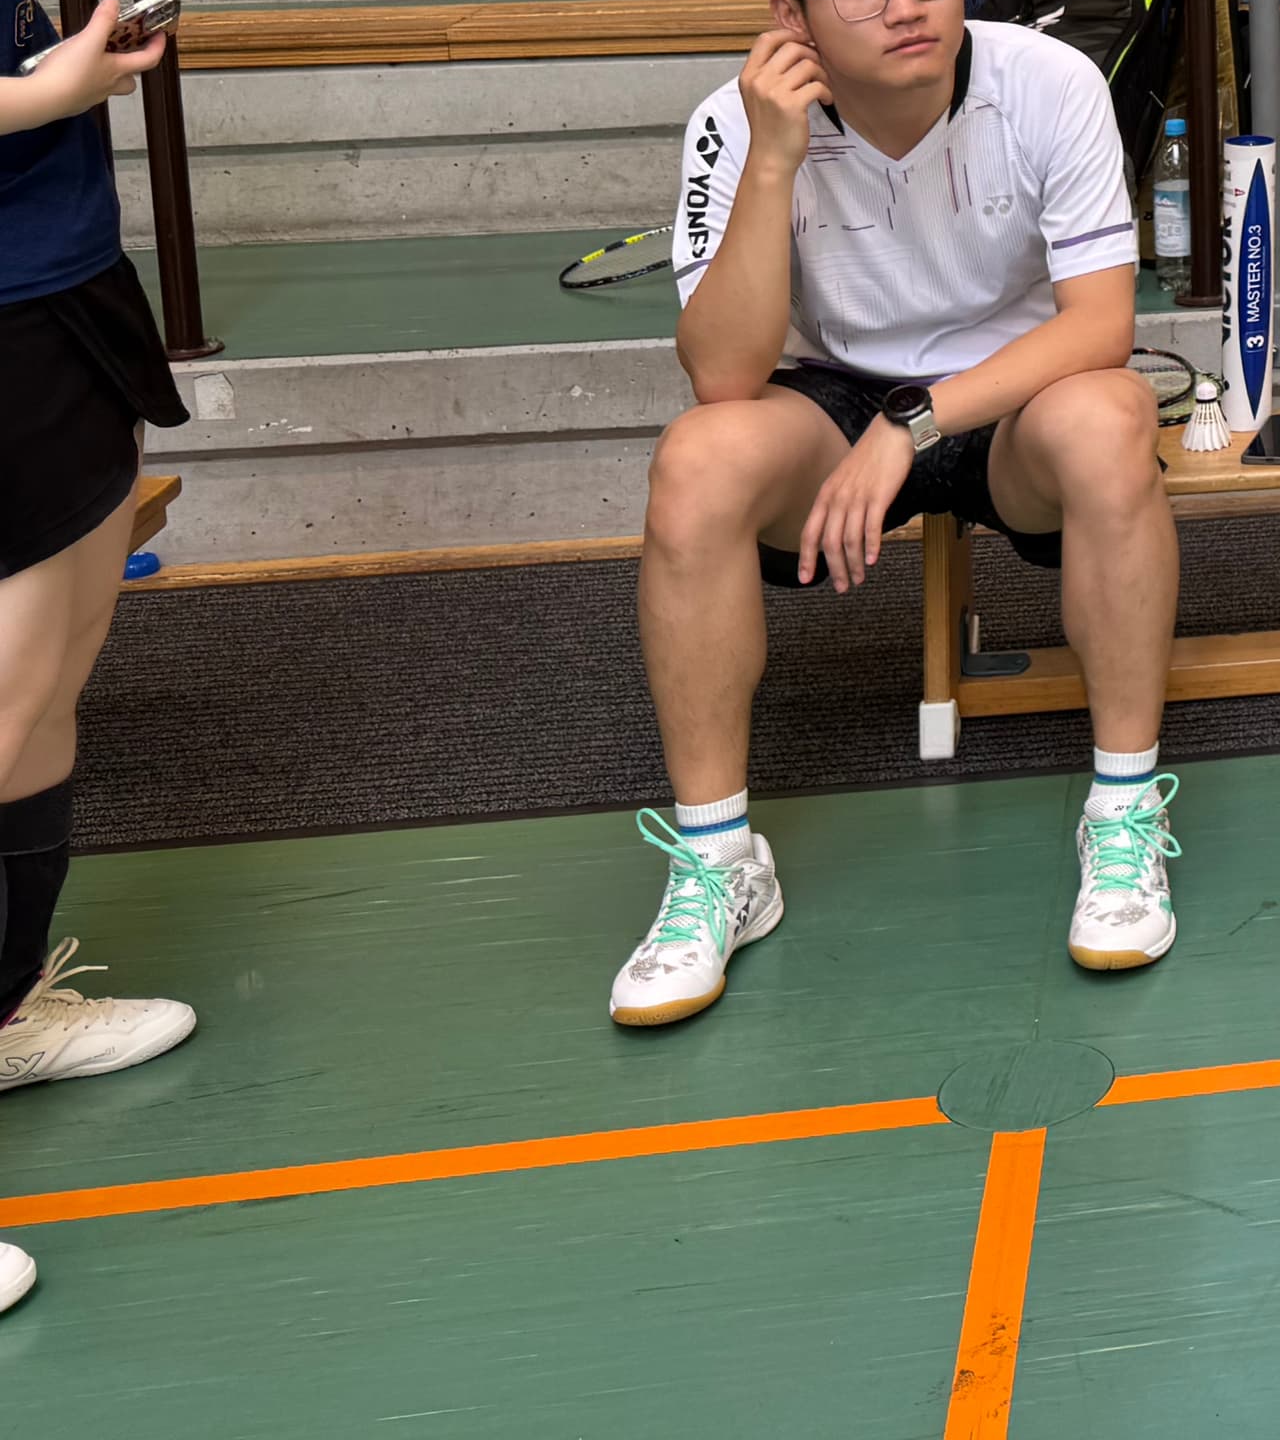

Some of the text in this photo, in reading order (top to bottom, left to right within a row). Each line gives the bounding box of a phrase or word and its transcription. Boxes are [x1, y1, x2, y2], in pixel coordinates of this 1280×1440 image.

[1246, 224, 1262, 323] MASTER NO.3
[1246, 334, 1265, 348] 3
